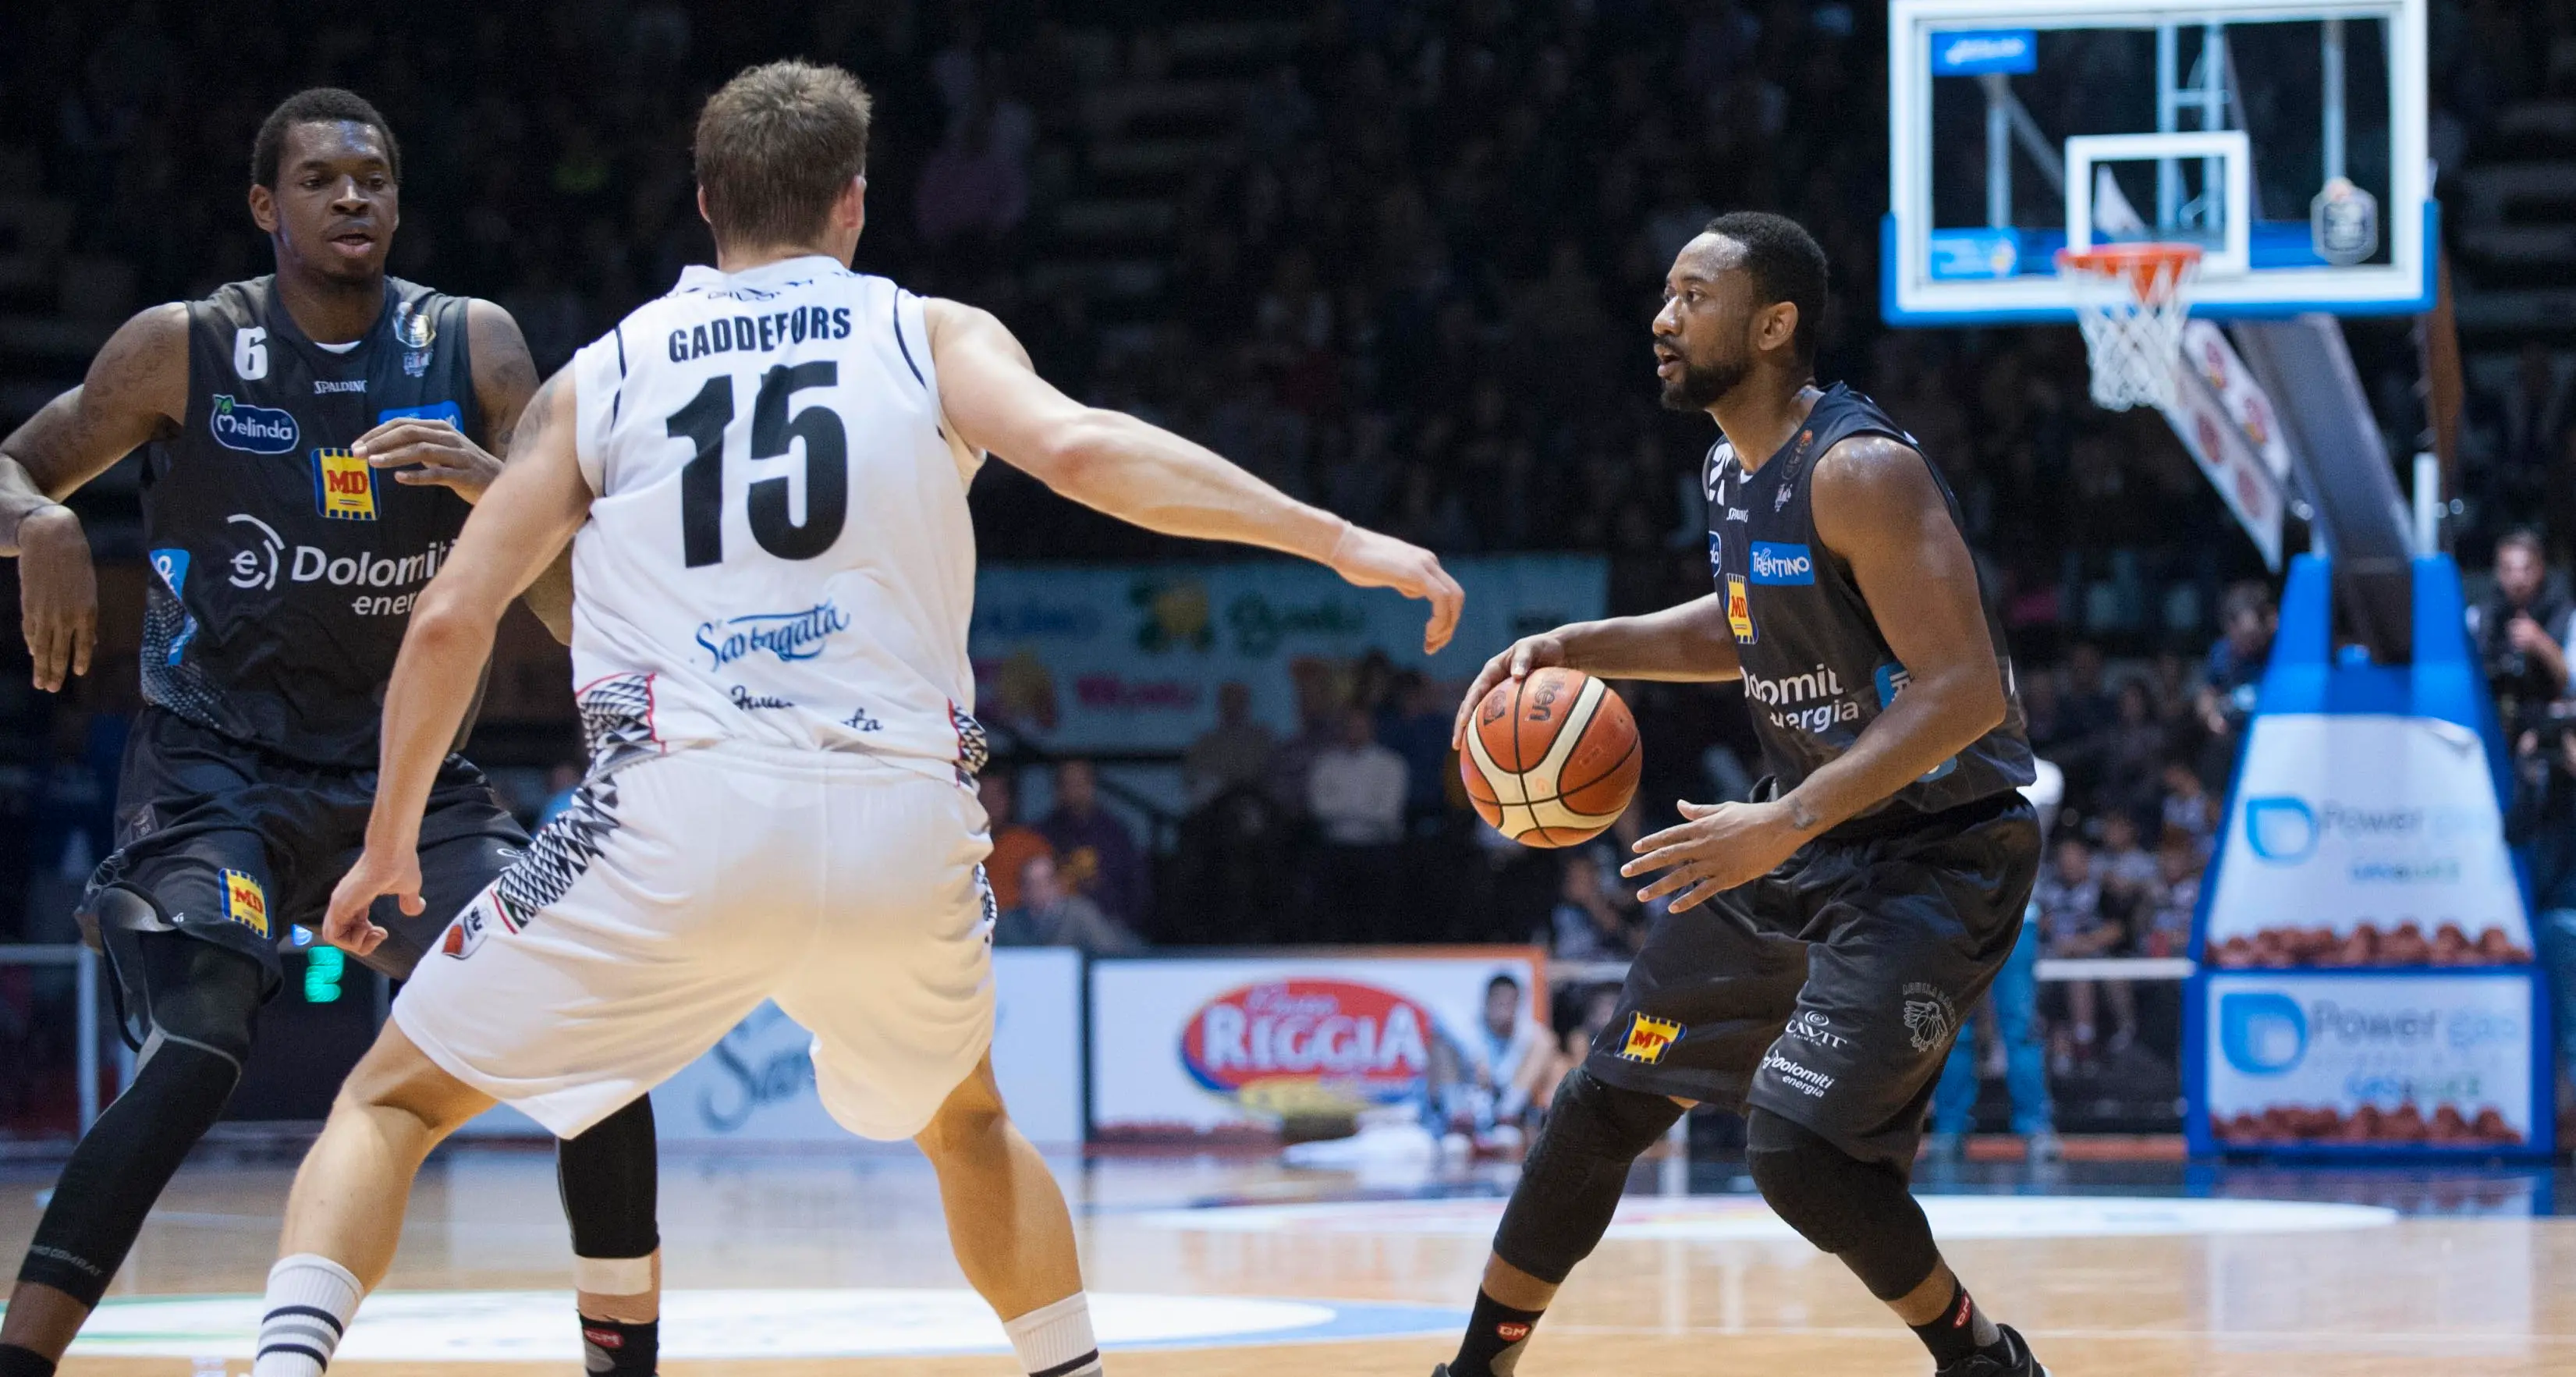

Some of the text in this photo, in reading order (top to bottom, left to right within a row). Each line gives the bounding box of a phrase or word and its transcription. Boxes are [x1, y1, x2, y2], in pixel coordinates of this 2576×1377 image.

[669, 305, 851, 363] GADDEFORS
[235, 326, 268, 381] 6
[217, 413, 293, 441] Melinda
[666, 360, 849, 569] 15
[327, 470, 369, 495] MD
[1752, 551, 1810, 577] TRENTINO
[352, 591, 419, 616] ener
[1730, 595, 1747, 619] MD
[235, 886, 264, 914] MD
[1785, 1019, 1848, 1049] CAVIT
[1771, 1056, 1835, 1089] Dolomiti
[1782, 1075, 1825, 1098] energia
